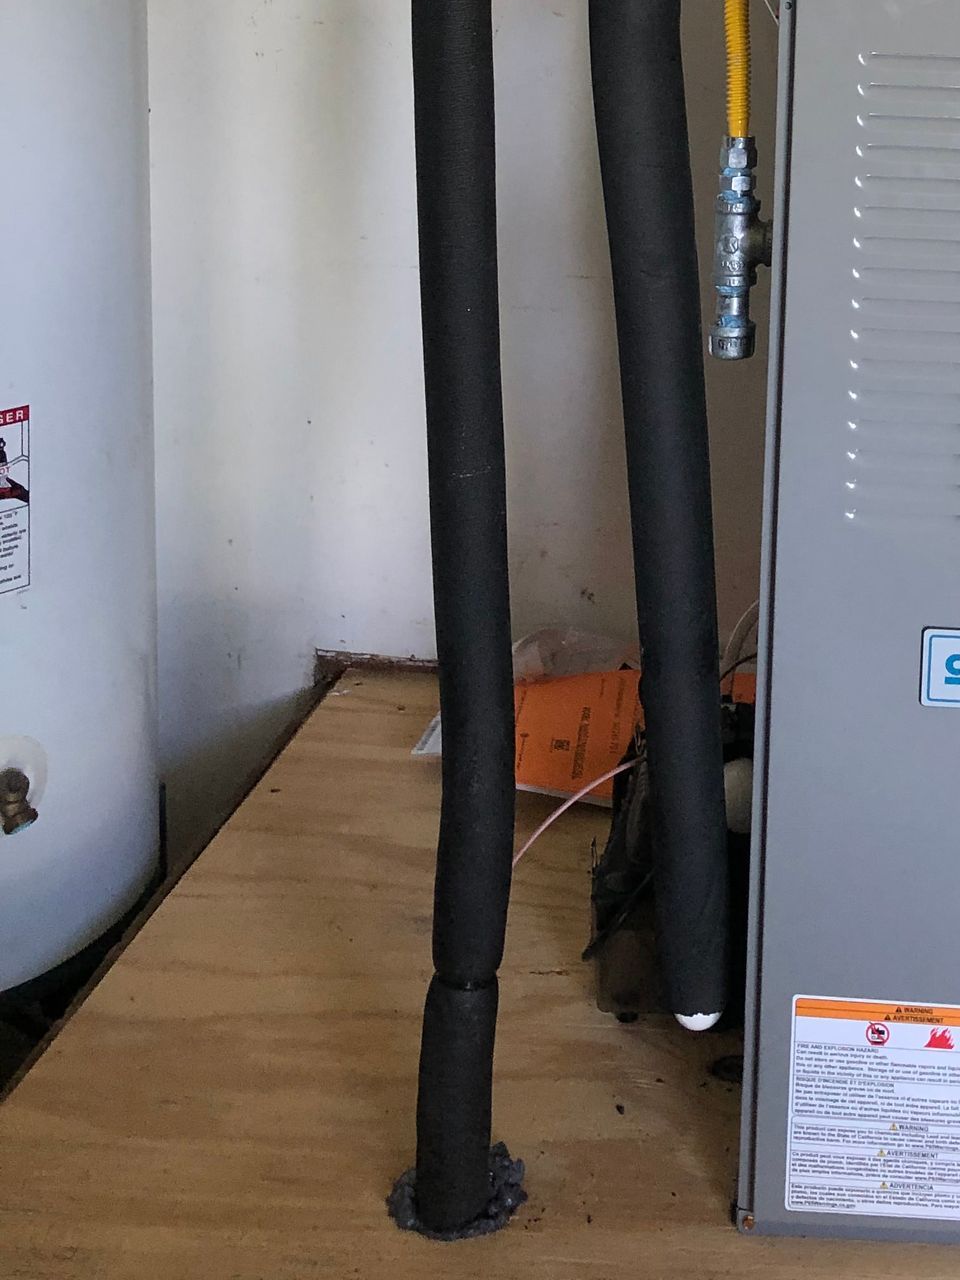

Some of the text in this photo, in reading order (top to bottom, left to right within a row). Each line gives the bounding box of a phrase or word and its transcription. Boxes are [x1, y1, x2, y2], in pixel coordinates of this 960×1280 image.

[903, 1006, 933, 1014] WARNING
[892, 1014, 944, 1023] AVERTISSEMENT
[899, 1124, 929, 1132] WARNING
[886, 1149, 938, 1158] AVERTISSEMENT
[889, 1182, 933, 1190] ADVERTENCIA
